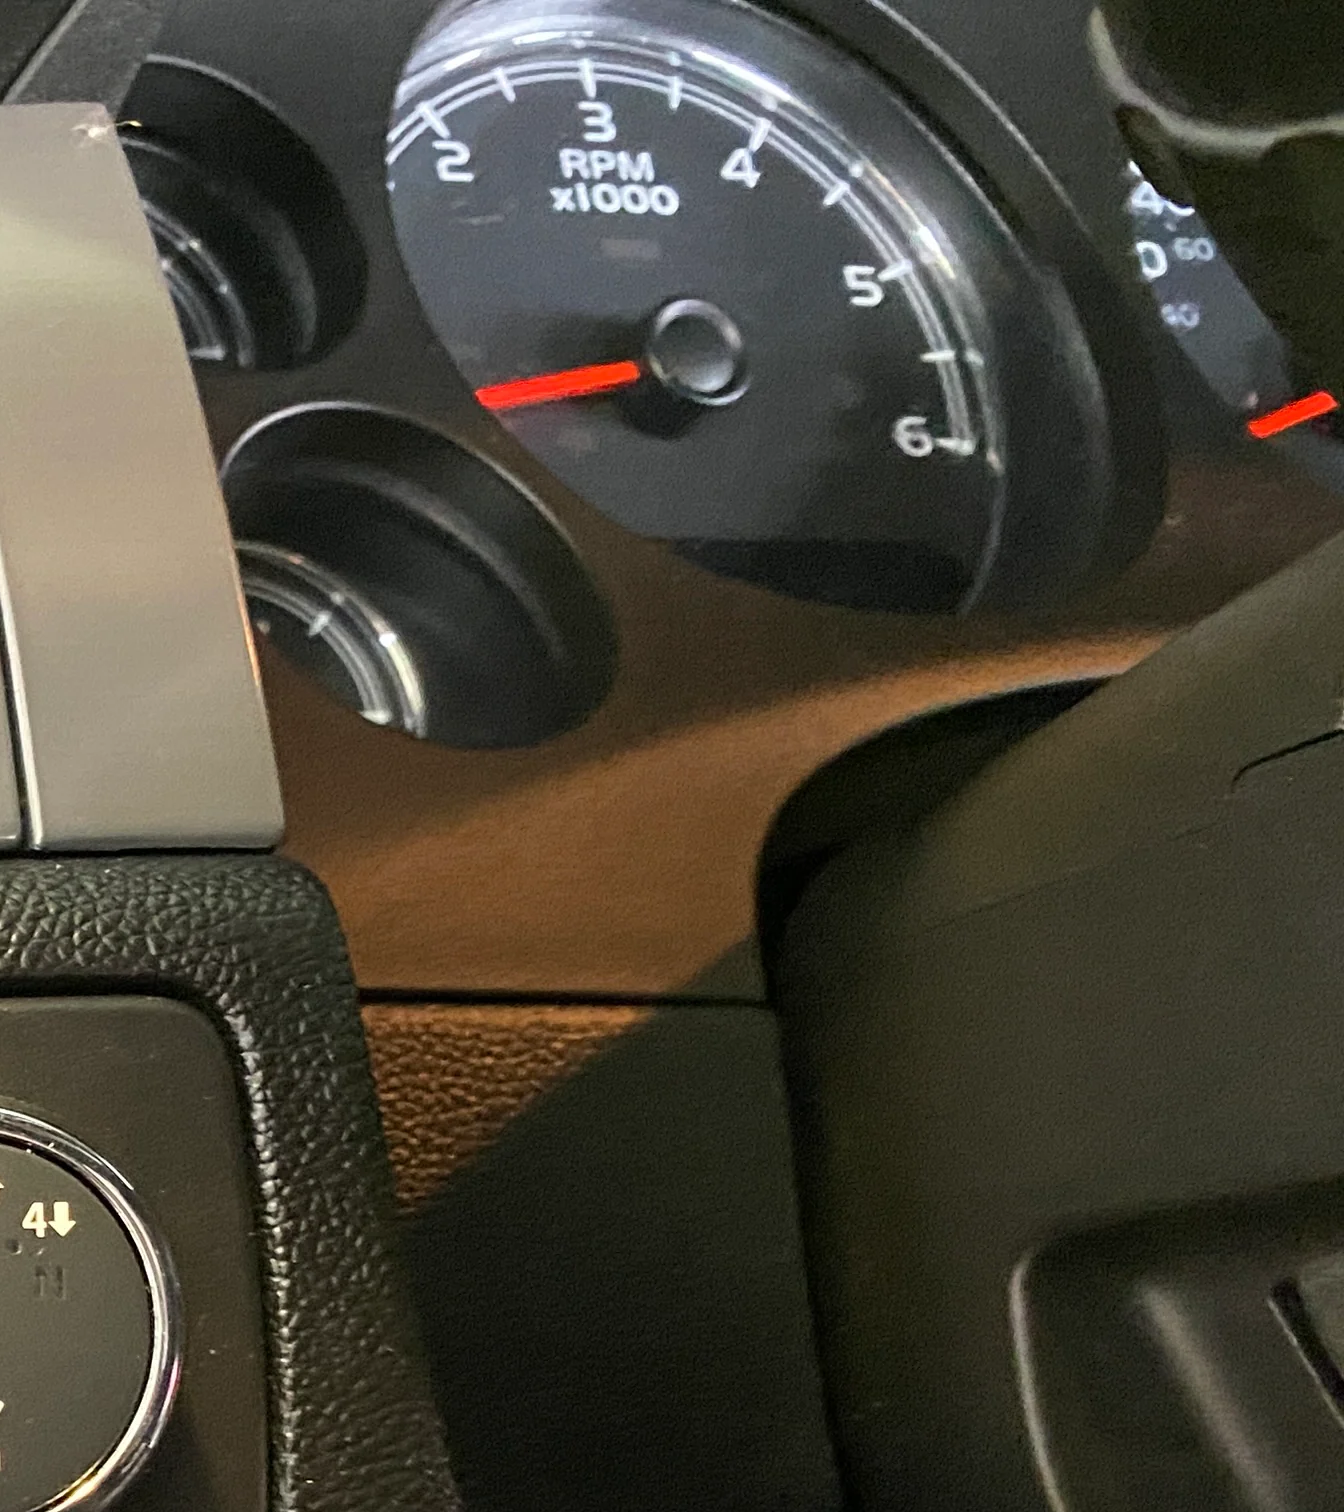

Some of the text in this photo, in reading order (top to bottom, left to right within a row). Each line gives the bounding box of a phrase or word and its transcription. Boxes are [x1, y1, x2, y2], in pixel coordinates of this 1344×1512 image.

[577, 102, 617, 143] 3
[433, 139, 475, 183] 2
[558, 148, 655, 183] RPM
[720, 147, 761, 189] 4
[842, 264, 885, 307] 5
[891, 415, 935, 458] 6
[21, 1202, 48, 1238] 4
